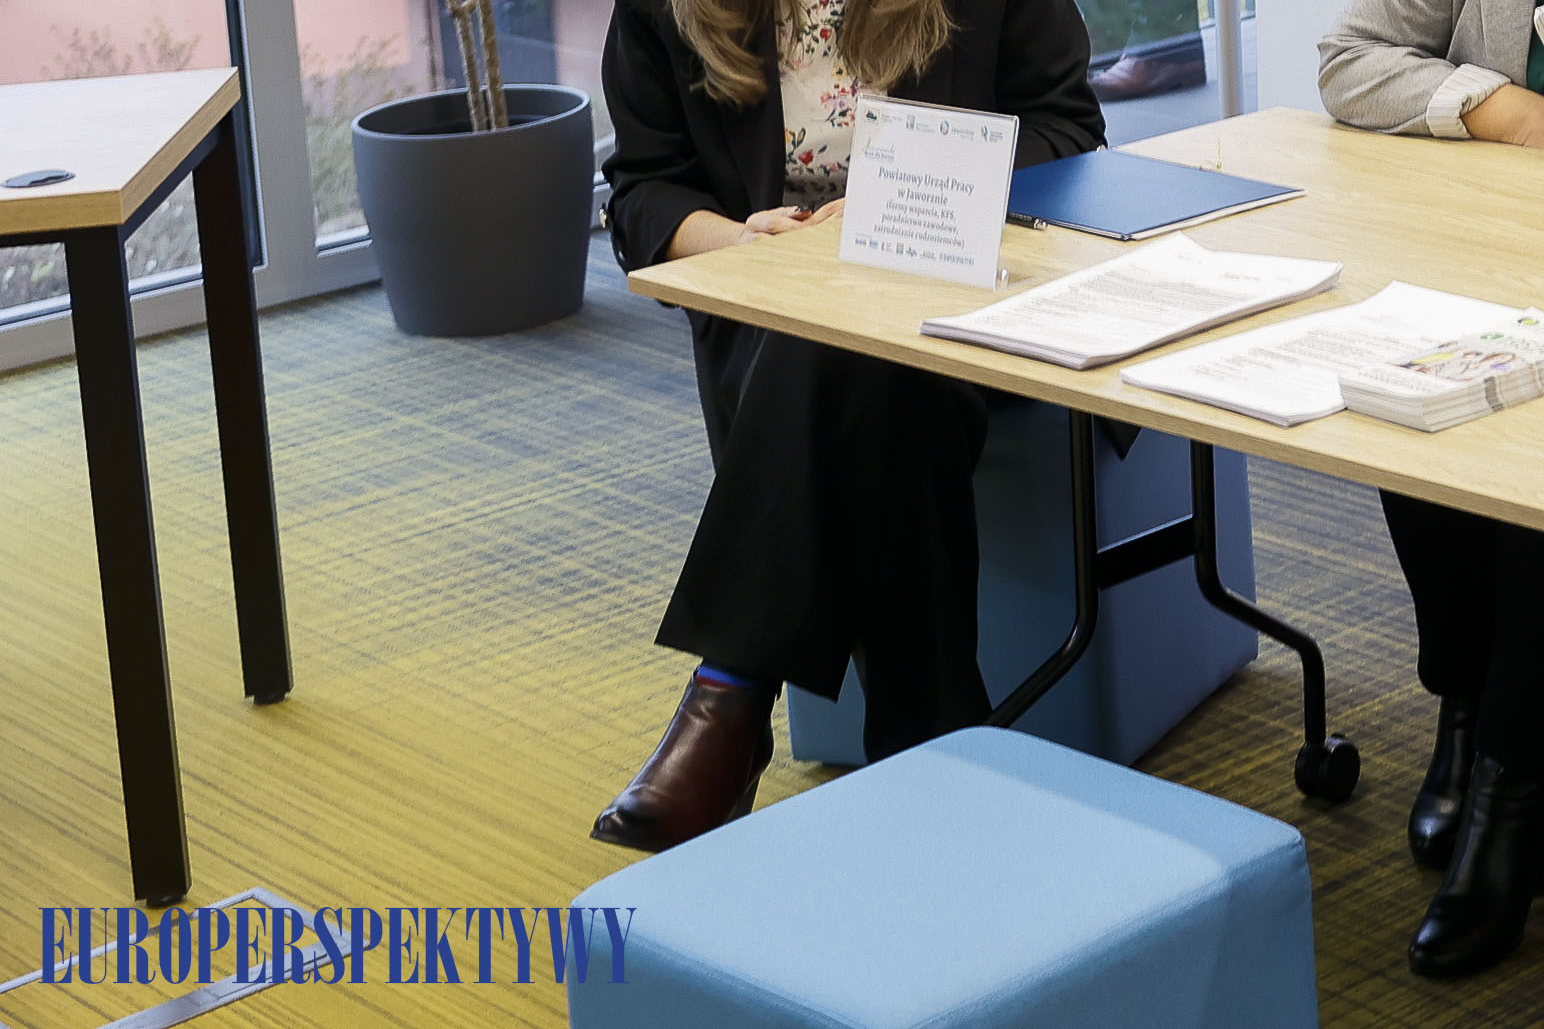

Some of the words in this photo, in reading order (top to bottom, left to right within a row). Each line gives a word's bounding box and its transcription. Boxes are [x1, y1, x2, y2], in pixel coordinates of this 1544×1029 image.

[878, 166, 923, 188] Powiatowy
[924, 174, 950, 191] Urząd
[950, 178, 975, 196] Pracy
[897, 188, 906, 199] w
[905, 187, 948, 206] Jaworznie
